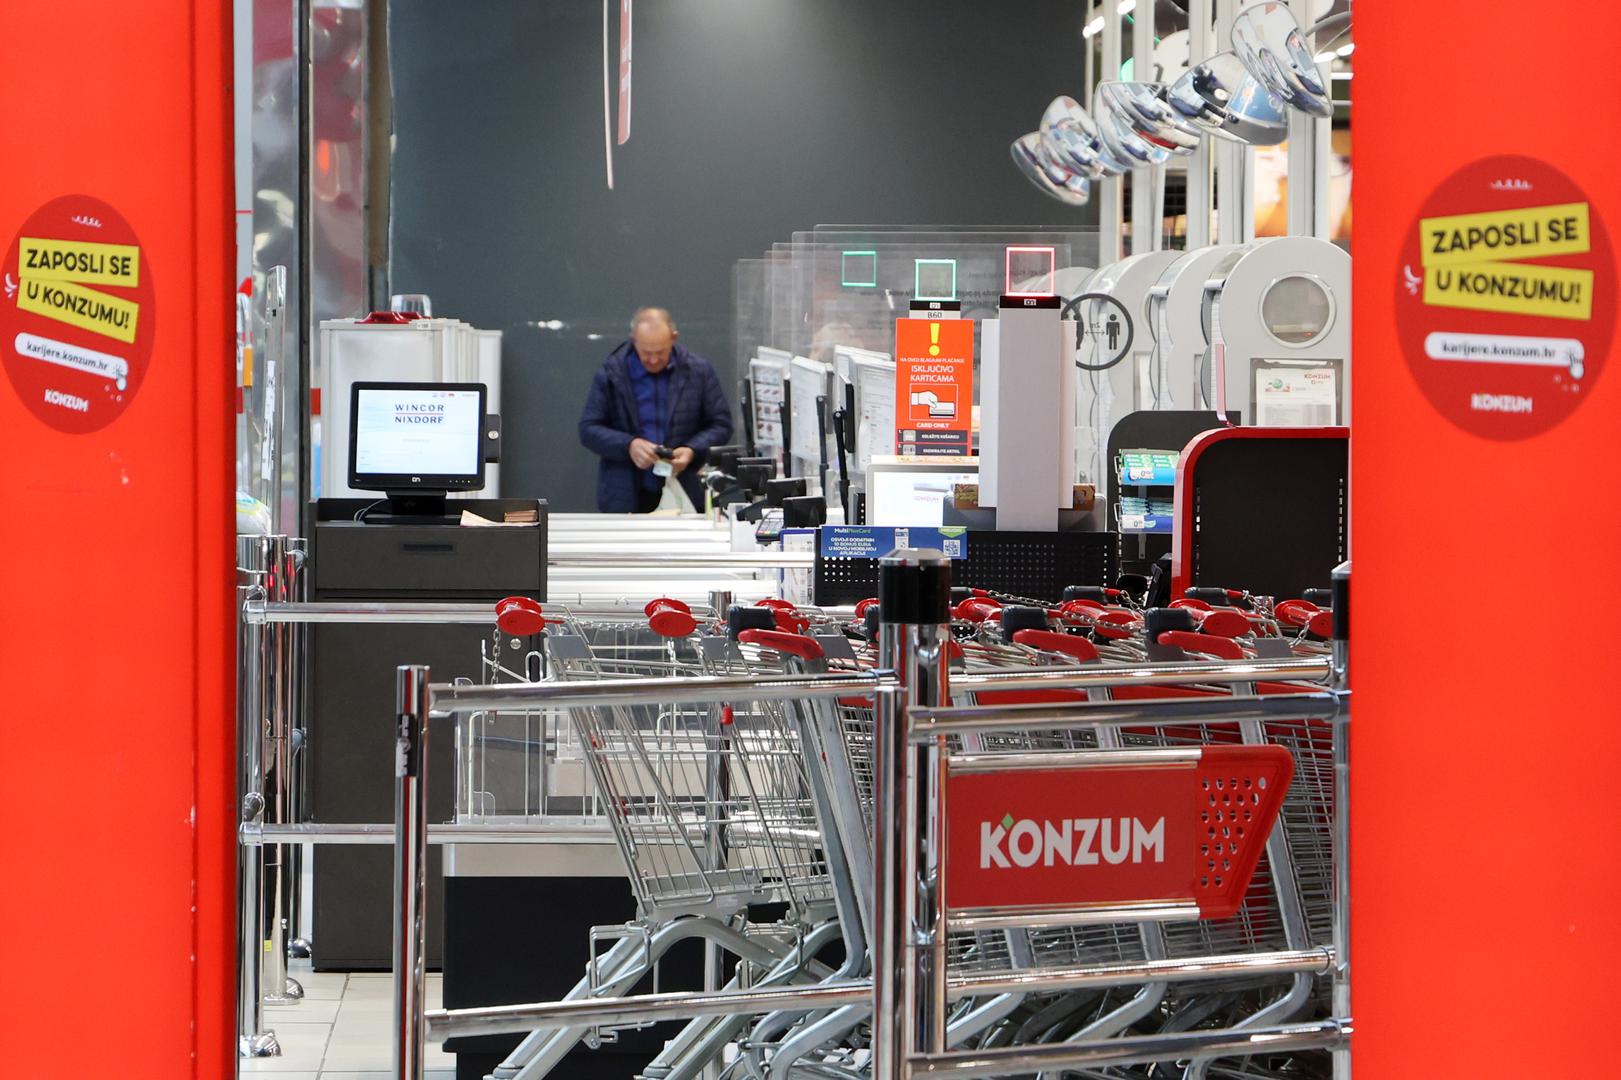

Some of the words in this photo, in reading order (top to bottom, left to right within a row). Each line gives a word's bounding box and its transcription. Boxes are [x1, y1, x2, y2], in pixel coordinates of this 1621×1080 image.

[1432, 221, 1540, 254] ZAPOSLI
[1548, 217, 1578, 242] SE
[26, 249, 104, 274] ZAPOSLI
[110, 256, 131, 276] SE
[1436, 270, 1452, 290] U
[1458, 272, 1581, 304] KONZUMU!
[27, 281, 38, 299] U
[43, 288, 130, 329] KONZUMU!
[26, 341, 108, 371] karijere.konzum.hr
[1442, 340, 1556, 360] karijere.konzum.hr
[910, 374, 954, 382] KARTICAMA
[911, 364, 954, 373] ISKLJUČIVO
[44, 388, 88, 412] KONZUM
[1471, 393, 1532, 414] KONZUM
[980, 816, 1166, 870] KONZUM
